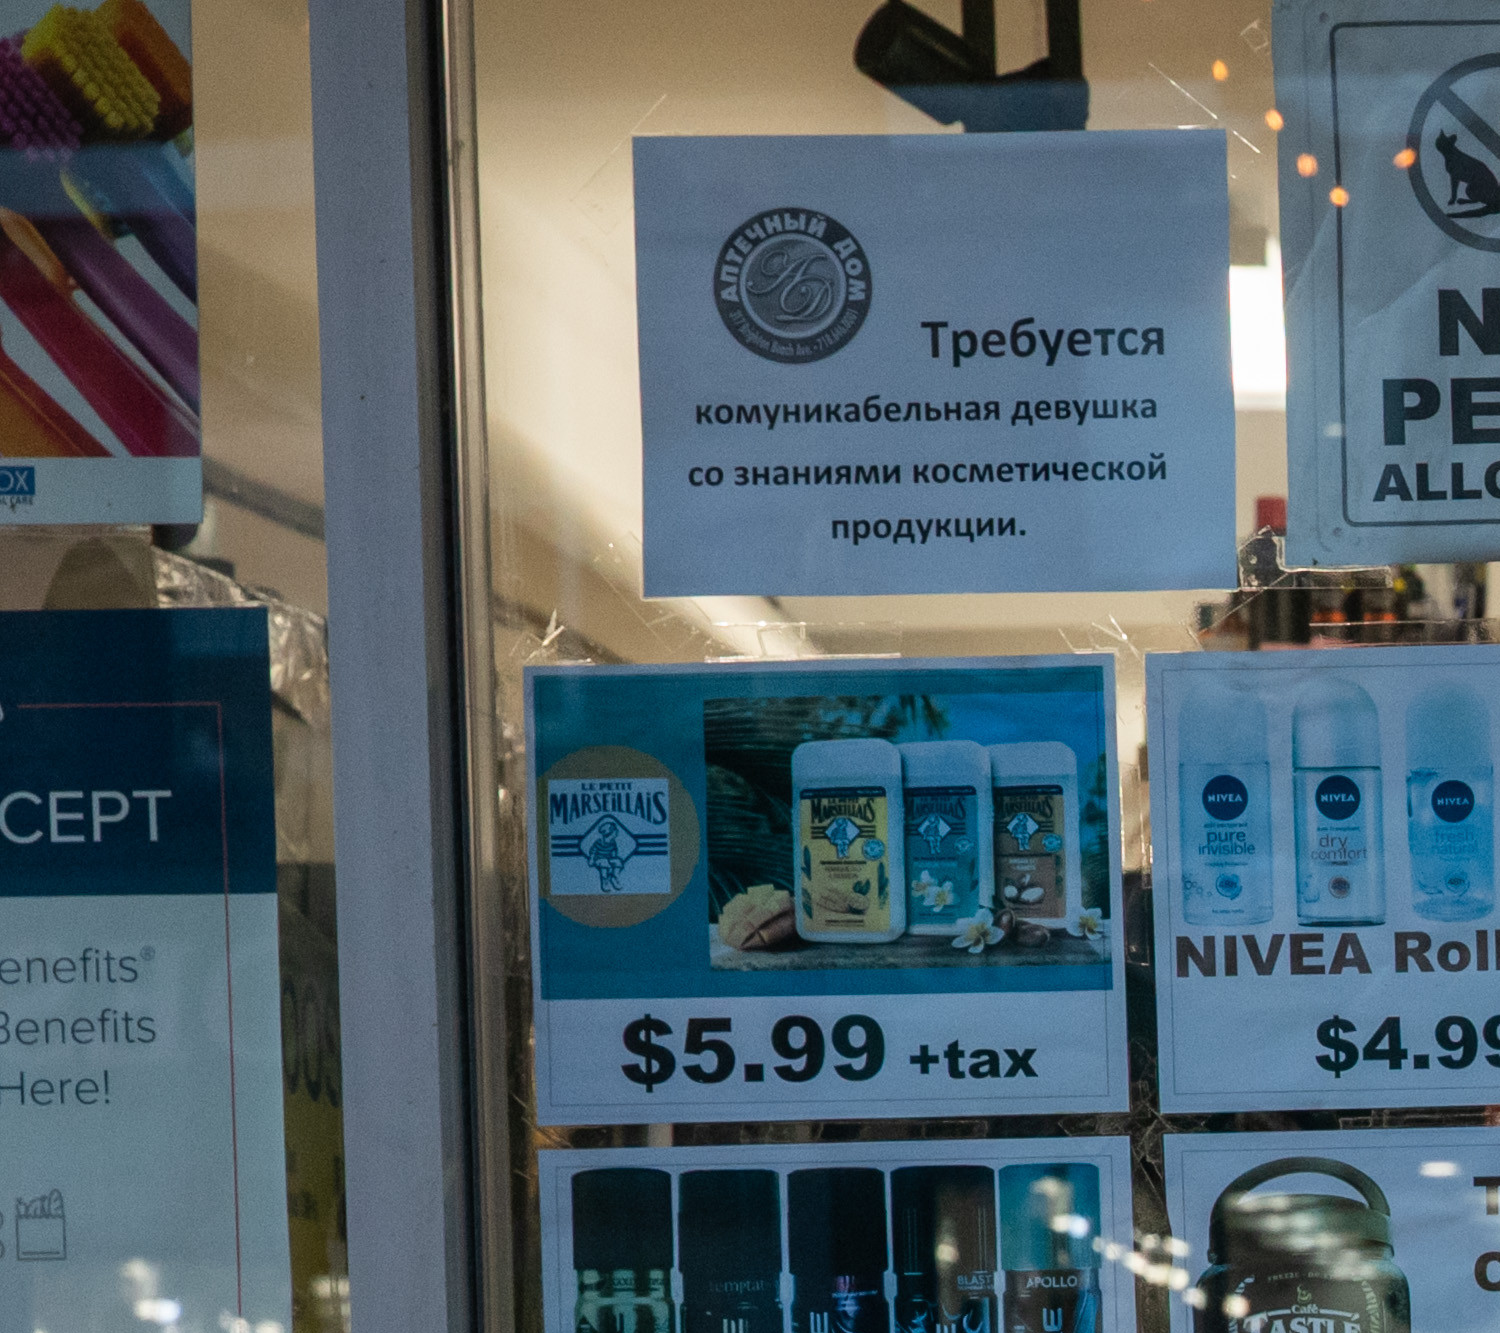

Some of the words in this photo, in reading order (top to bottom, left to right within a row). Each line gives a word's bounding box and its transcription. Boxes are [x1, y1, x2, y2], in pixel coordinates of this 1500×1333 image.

[720, 213, 827, 302] АПТЕЧНЫЙ
[833, 238, 867, 301] ДОМ
[921, 317, 1166, 367] Требуется
[695, 396, 1001, 429] комуникабельная
[1010, 396, 1158, 426] девушка
[688, 462, 724, 487] со
[734, 460, 901, 486] знаниями
[912, 453, 1168, 485] косметической
[831, 514, 1027, 545] продукции.
[1208, 794, 1243, 802] NIVEA
[1198, 843, 1255, 855] invisible
[1207, 831, 1246, 845] pure
[1177, 933, 1372, 978] NIVEA
[622, 1014, 885, 1093] $5.99
[910, 1040, 1038, 1079] +tax
